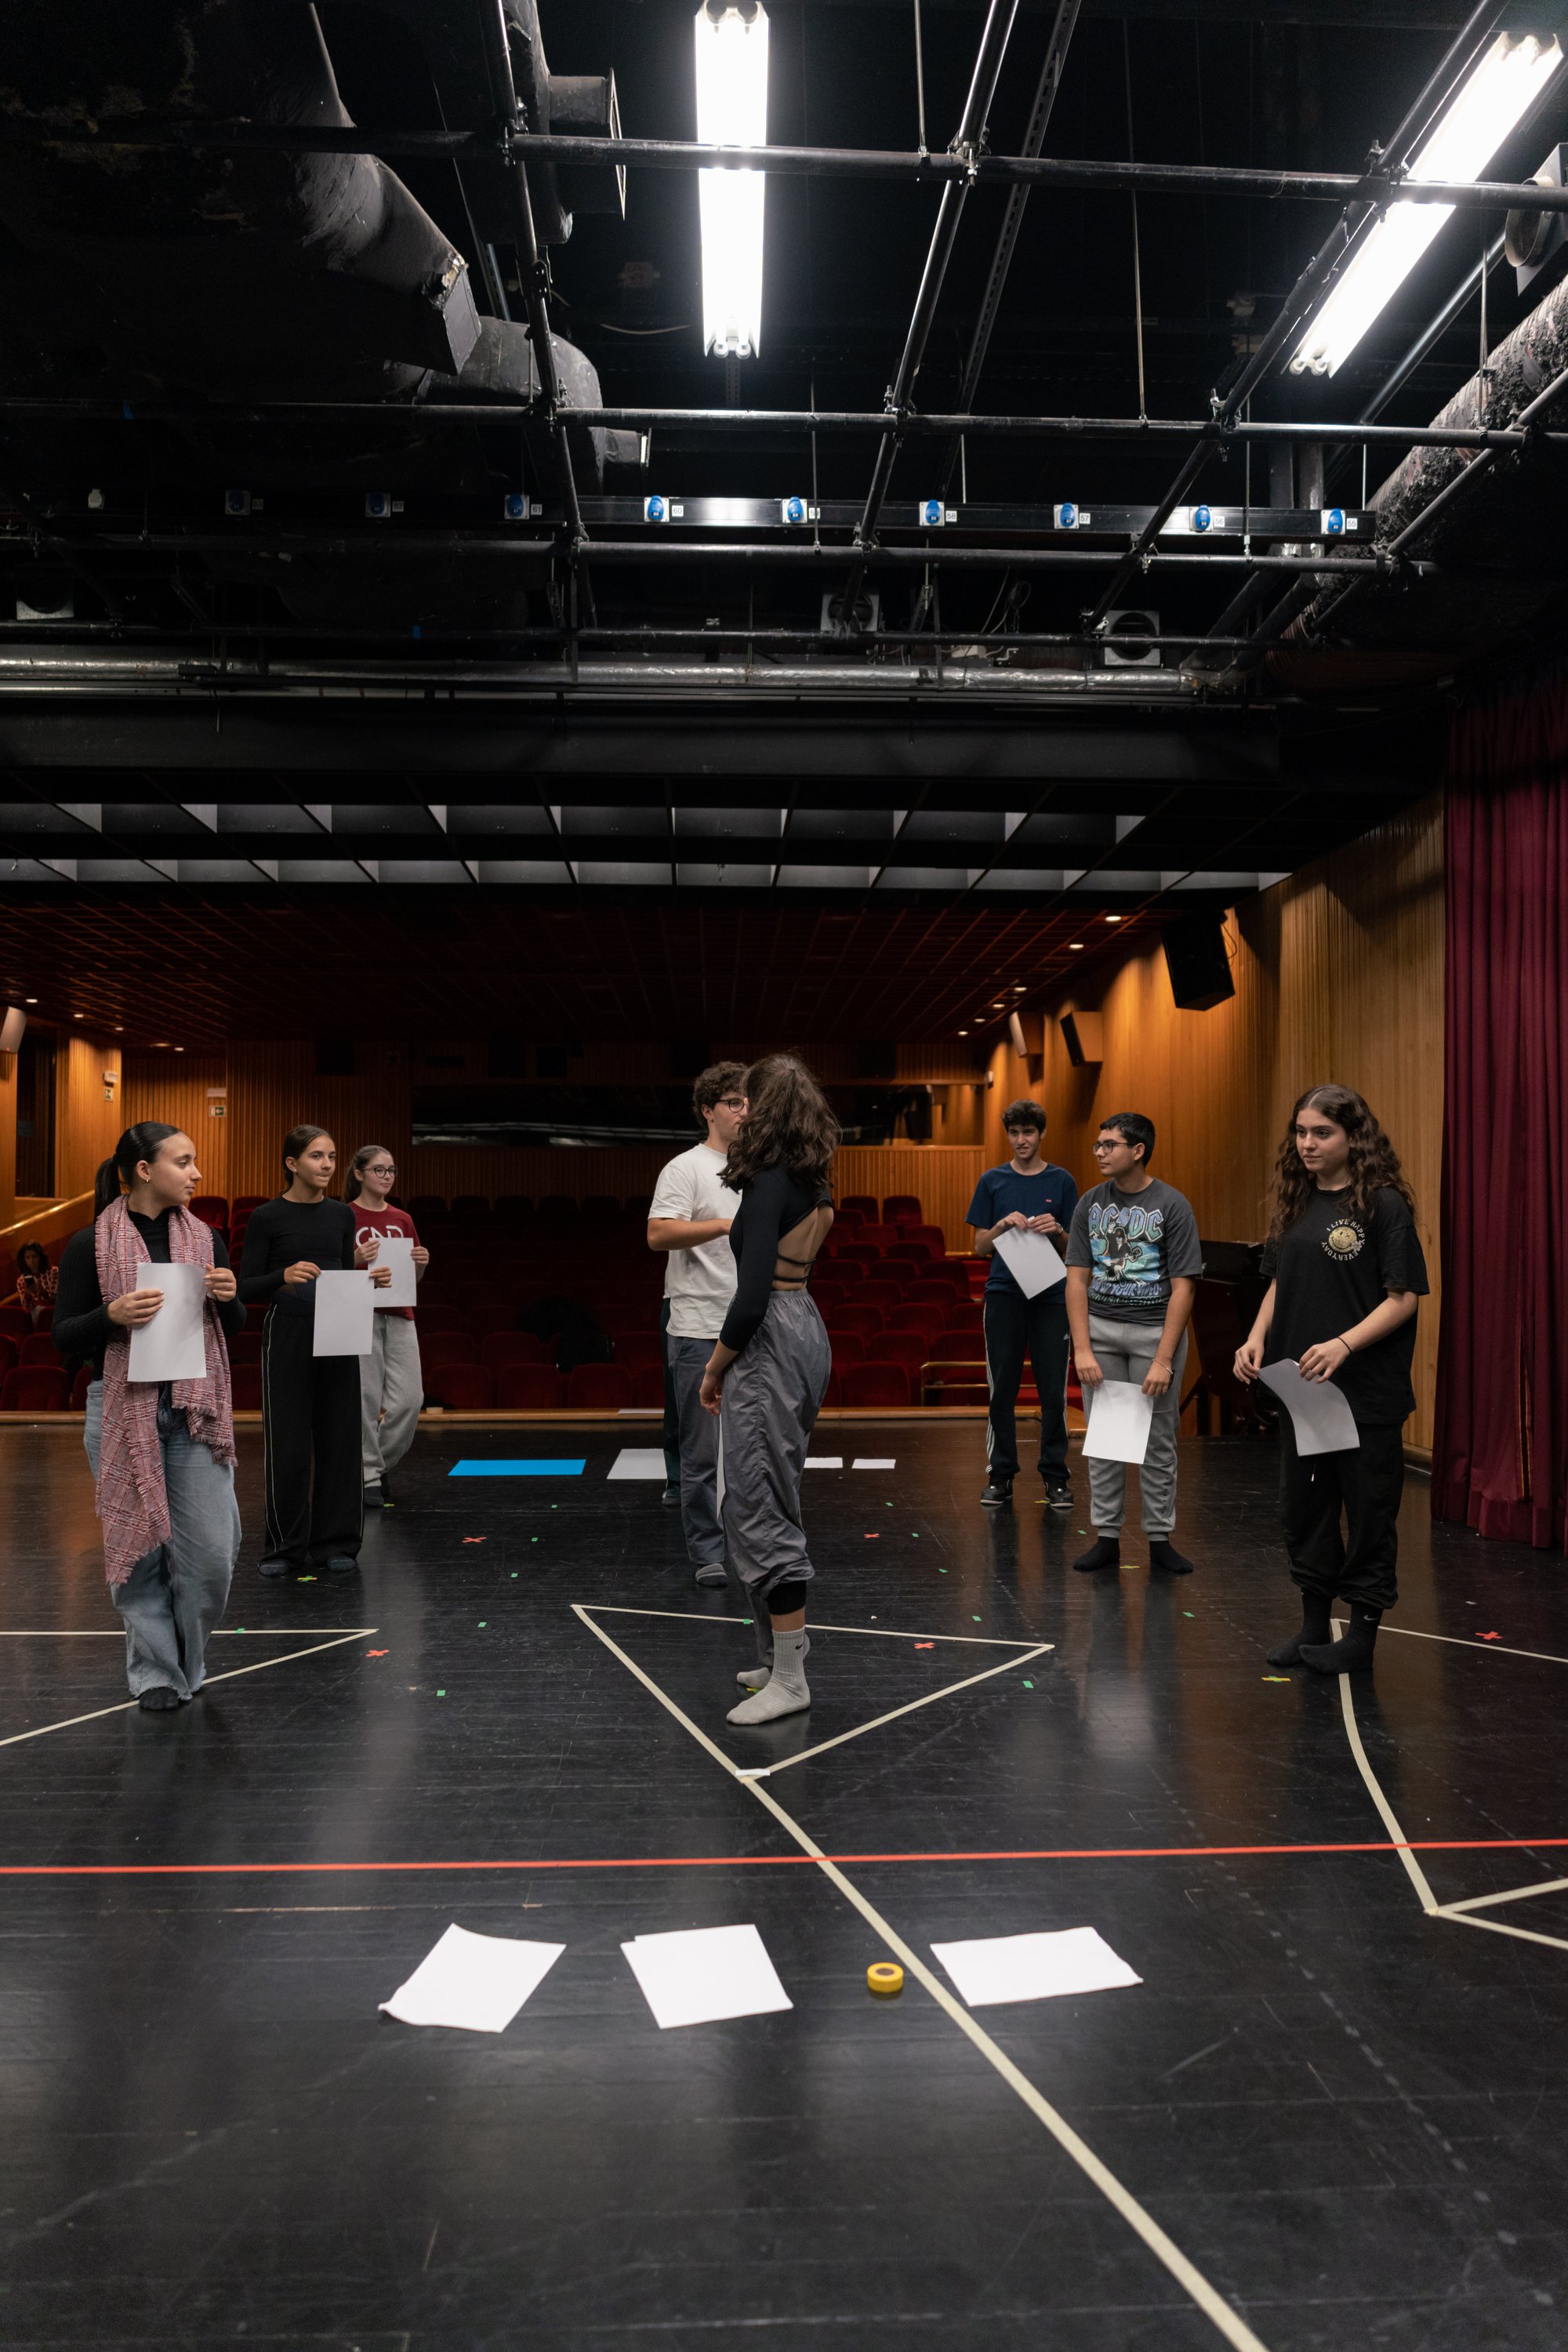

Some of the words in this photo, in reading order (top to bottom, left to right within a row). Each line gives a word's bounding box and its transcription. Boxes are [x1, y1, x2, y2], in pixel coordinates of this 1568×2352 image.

[1330, 1218, 1349, 1229] LIVE
[1350, 1221, 1365, 1244] HAPPY
[1321, 1242, 1359, 1261] EVERYDAY
